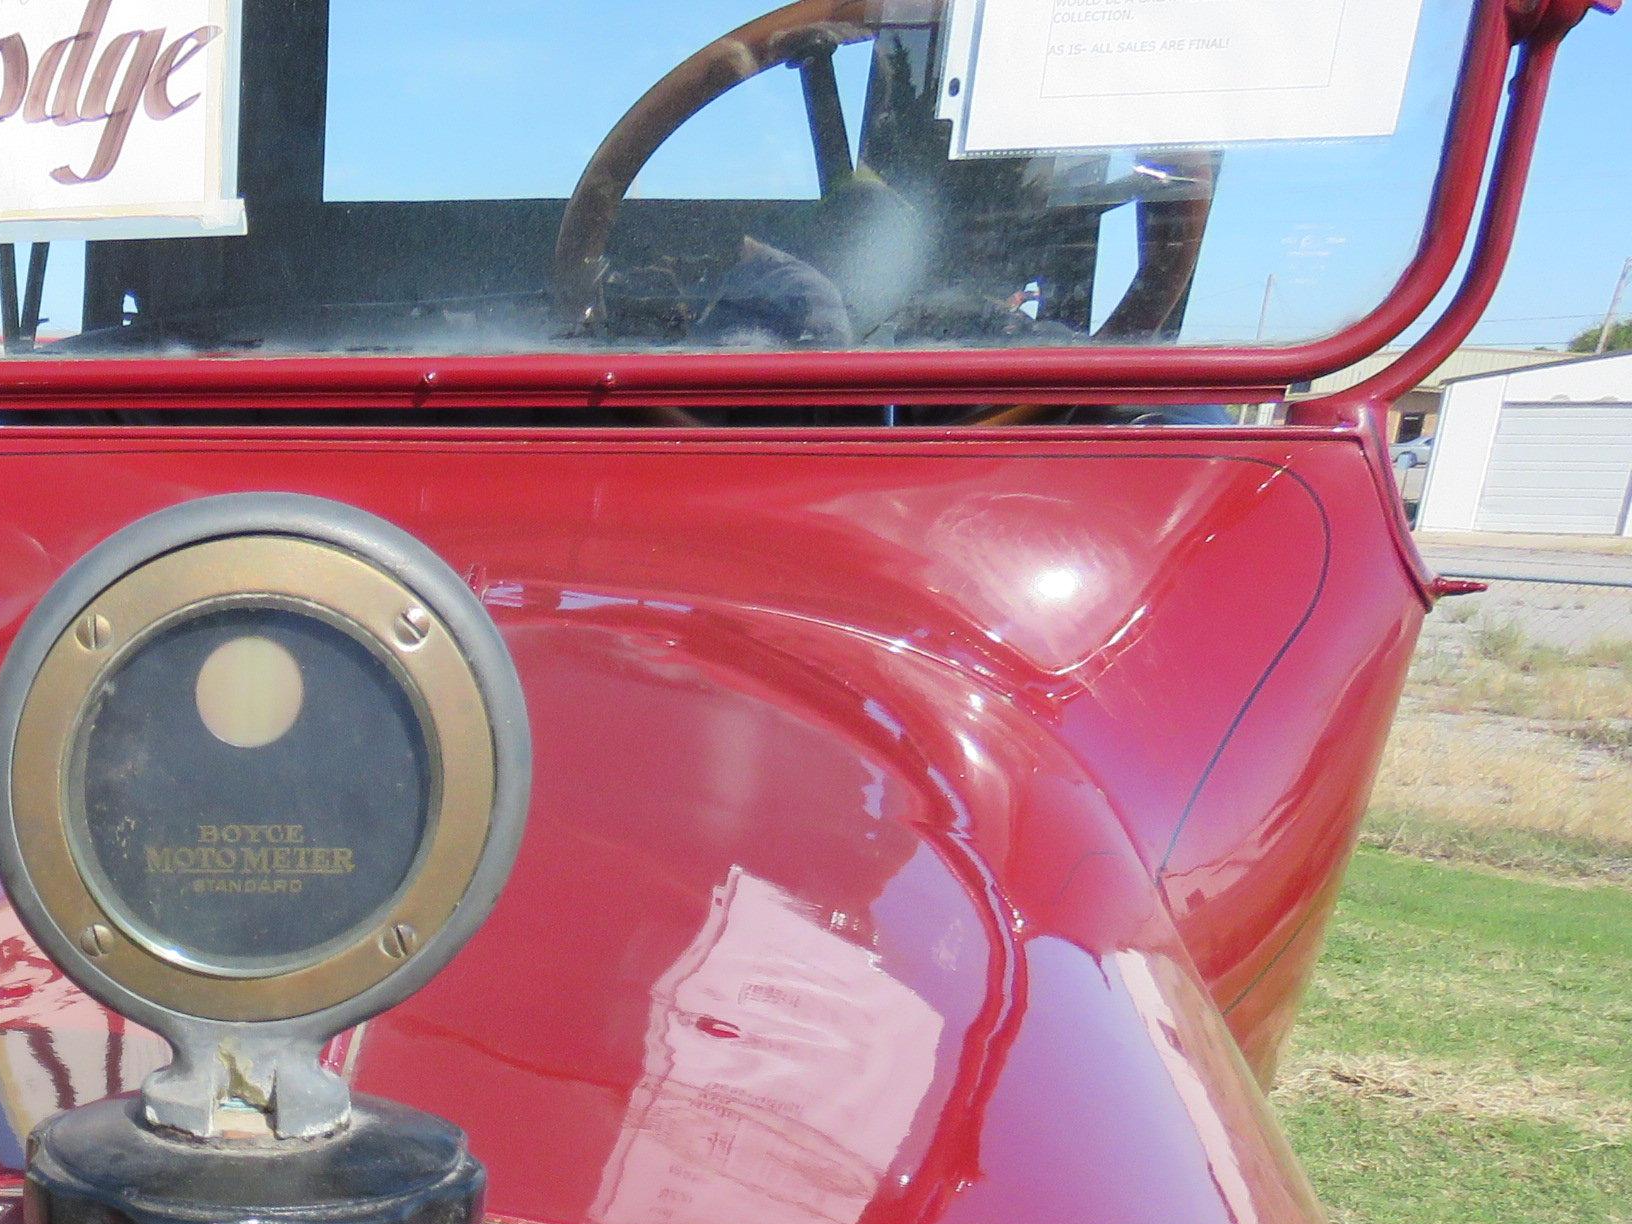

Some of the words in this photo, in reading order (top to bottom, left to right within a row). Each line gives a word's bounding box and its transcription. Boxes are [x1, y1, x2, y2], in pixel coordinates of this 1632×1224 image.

[1053, 9, 1135, 23] COLLECTION.
[1091, 42, 1113, 53] ALL
[1117, 40, 1156, 53] SALES
[1159, 39, 1186, 51] ARE
[197, 824, 304, 843] BOYCE
[192, 879, 303, 893] STANDARD
